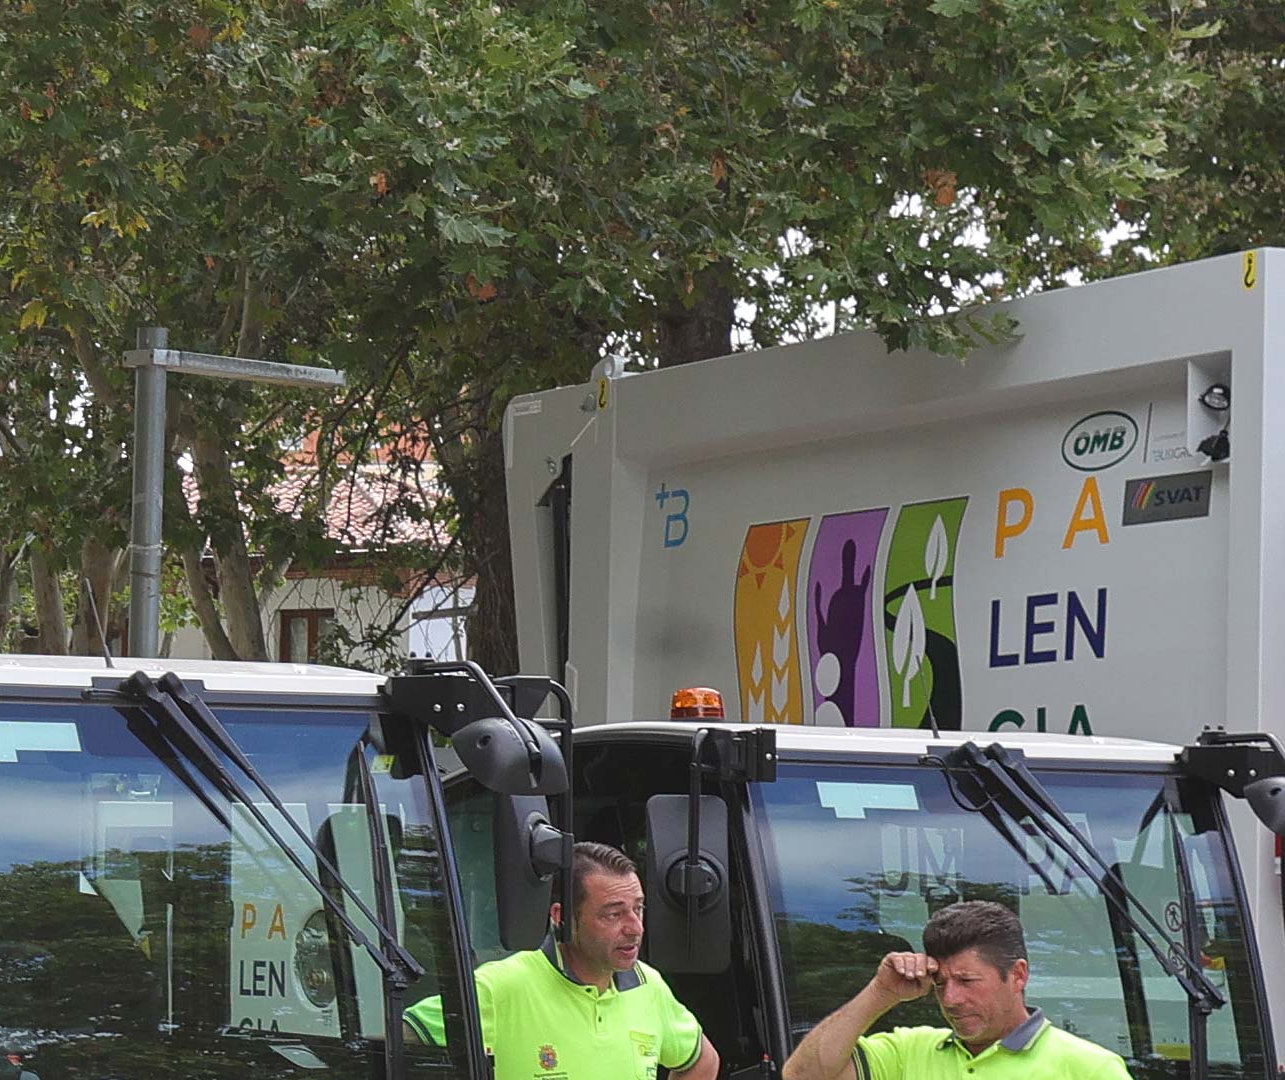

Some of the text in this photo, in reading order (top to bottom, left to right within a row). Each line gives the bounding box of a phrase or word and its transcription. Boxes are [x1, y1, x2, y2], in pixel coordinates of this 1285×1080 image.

[1073, 429, 1127, 456] OMB
[1154, 485, 1204, 507] SVAT
[990, 587, 1108, 668] LEN
[239, 960, 286, 998] LEN
